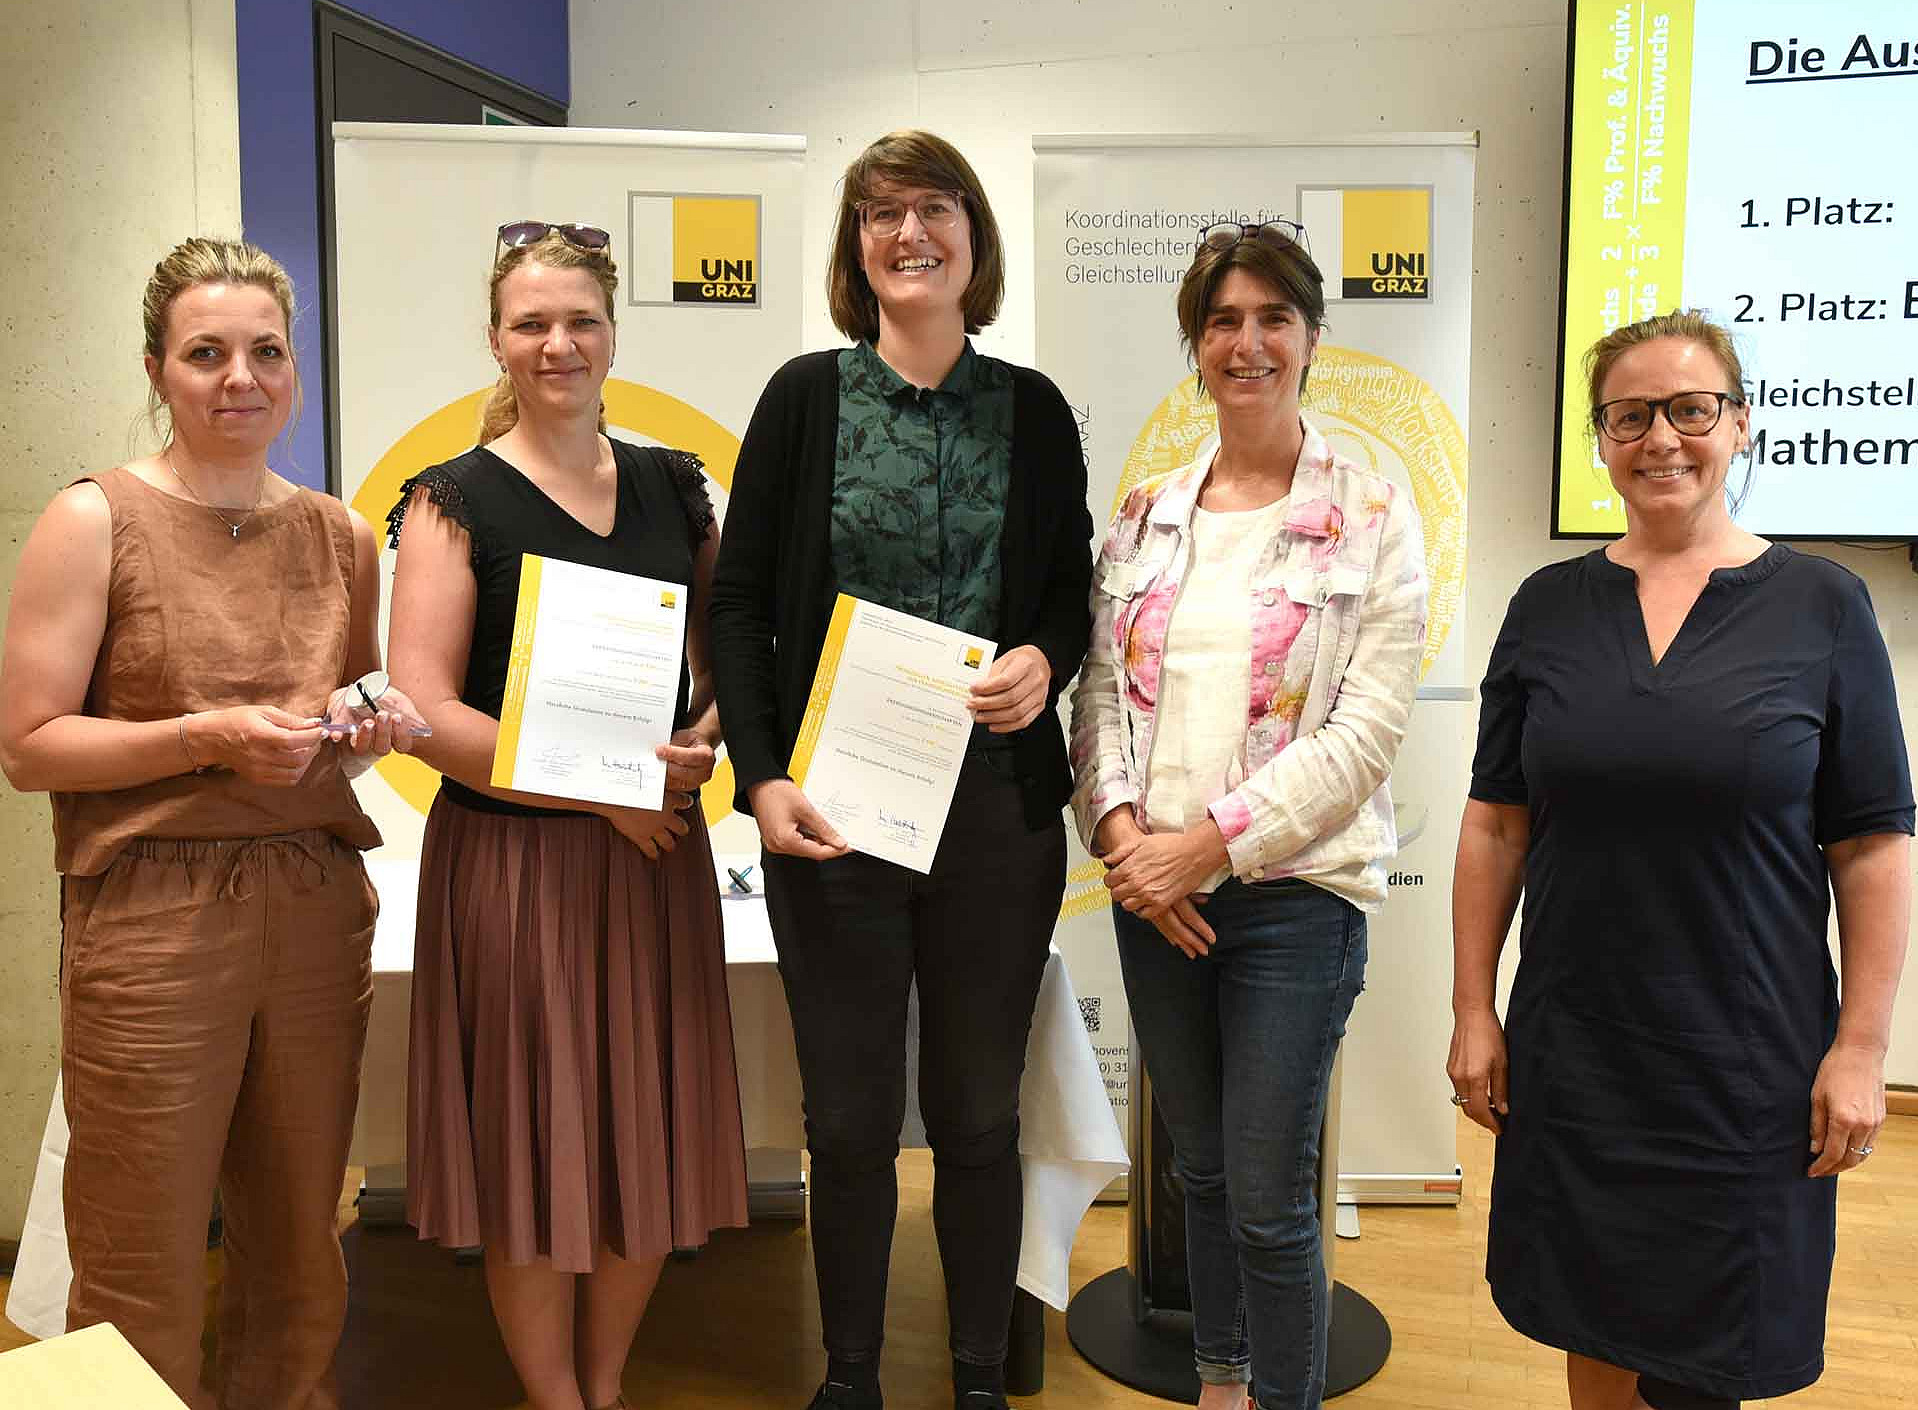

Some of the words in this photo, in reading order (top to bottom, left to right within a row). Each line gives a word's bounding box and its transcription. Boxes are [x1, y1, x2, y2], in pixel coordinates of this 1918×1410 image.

[1602, 3, 1634, 83] Äquiv.
[1749, 37, 1825, 76] Die
[1643, 14, 1670, 157] Nachwuchs
[1607, 88, 1627, 108] &
[1605, 114, 1627, 173] Prof.
[1064, 208, 1251, 229] Koordinationsstelle
[1740, 199, 1770, 228] 1.
[1786, 196, 1893, 226] Platz:
[1371, 252, 1425, 276] UNI
[1601, 245, 1622, 261] 2
[1639, 244, 1660, 261] 3
[700, 259, 753, 282] UNI
[700, 283, 753, 299] GRAZ
[1371, 278, 1425, 293] GRAZ
[1733, 293, 1765, 323] 2.
[1780, 292, 1887, 322] Platz:
[1744, 377, 1916, 407] leichstel
[1387, 871, 1424, 886] dien
